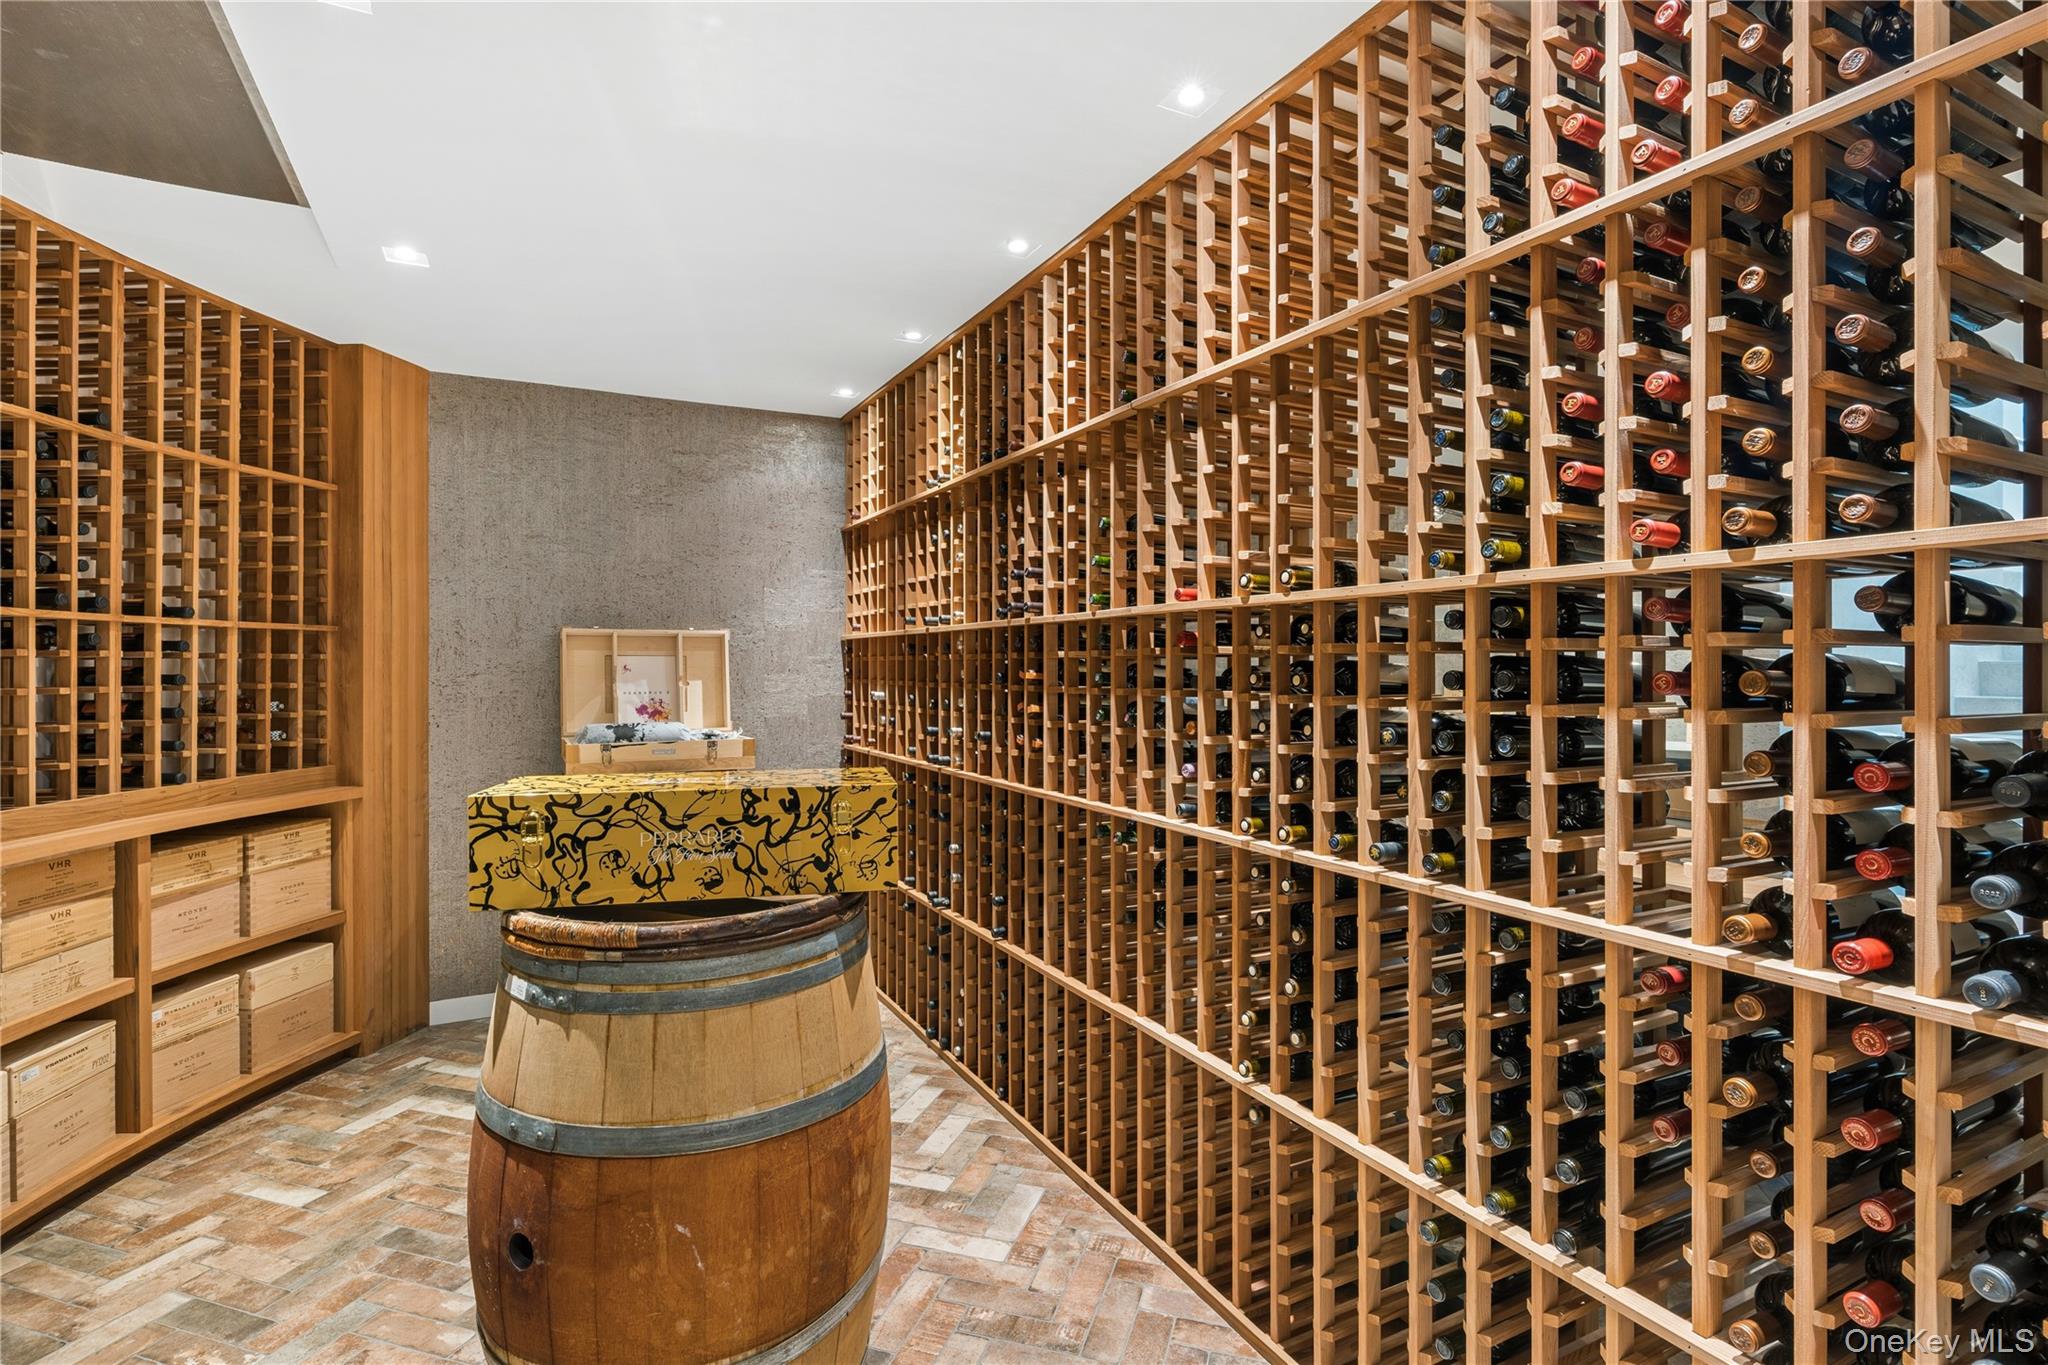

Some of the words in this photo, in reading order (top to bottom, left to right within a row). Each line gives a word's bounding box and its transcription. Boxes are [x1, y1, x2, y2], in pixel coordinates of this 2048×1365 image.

[283, 831, 300, 840] VHR
[640, 829, 745, 847] PERRARUS
[188, 850, 207, 860] VHR
[48, 859, 71, 871] VHR
[50, 909, 72, 921] VHR
